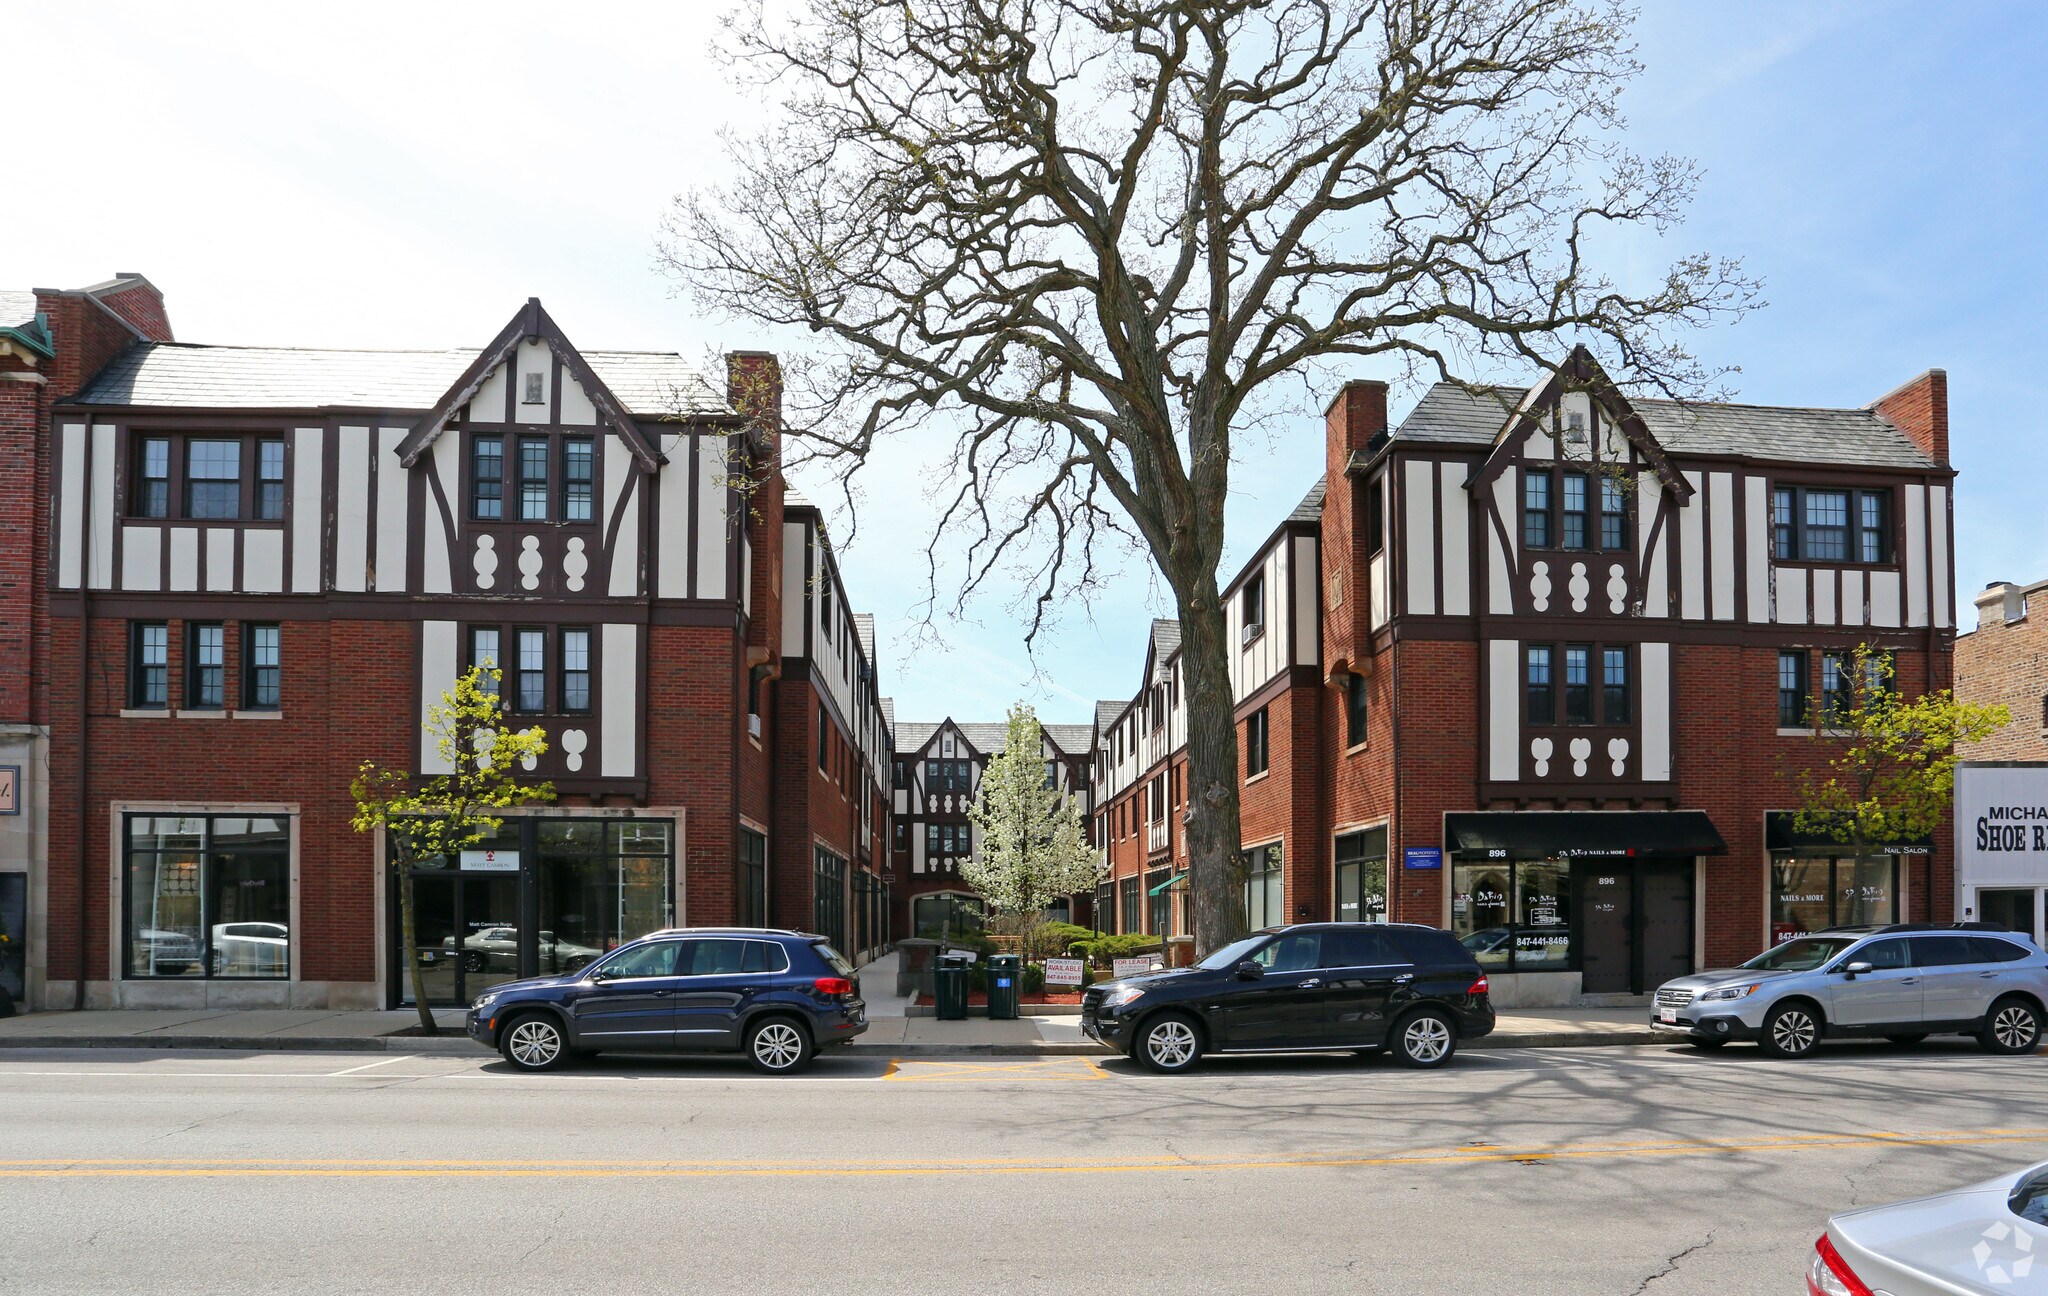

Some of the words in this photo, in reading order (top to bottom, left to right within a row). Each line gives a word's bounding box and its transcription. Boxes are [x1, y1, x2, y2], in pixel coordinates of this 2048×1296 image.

[1989, 806, 2048, 820] MICHA
[1977, 816, 2026, 852] SHOE
[2032, 825, 2048, 852] R
[1488, 849, 1506, 857] 896
[1903, 846, 1928, 854] SALON
[1598, 877, 1615, 885] 896
[1780, 894, 1800, 902] NAILS
[1806, 894, 1824, 902] MORE
[1516, 936, 1568, 946] 847-441-8466
[1047, 964, 1083, 973] AVAILABLE
